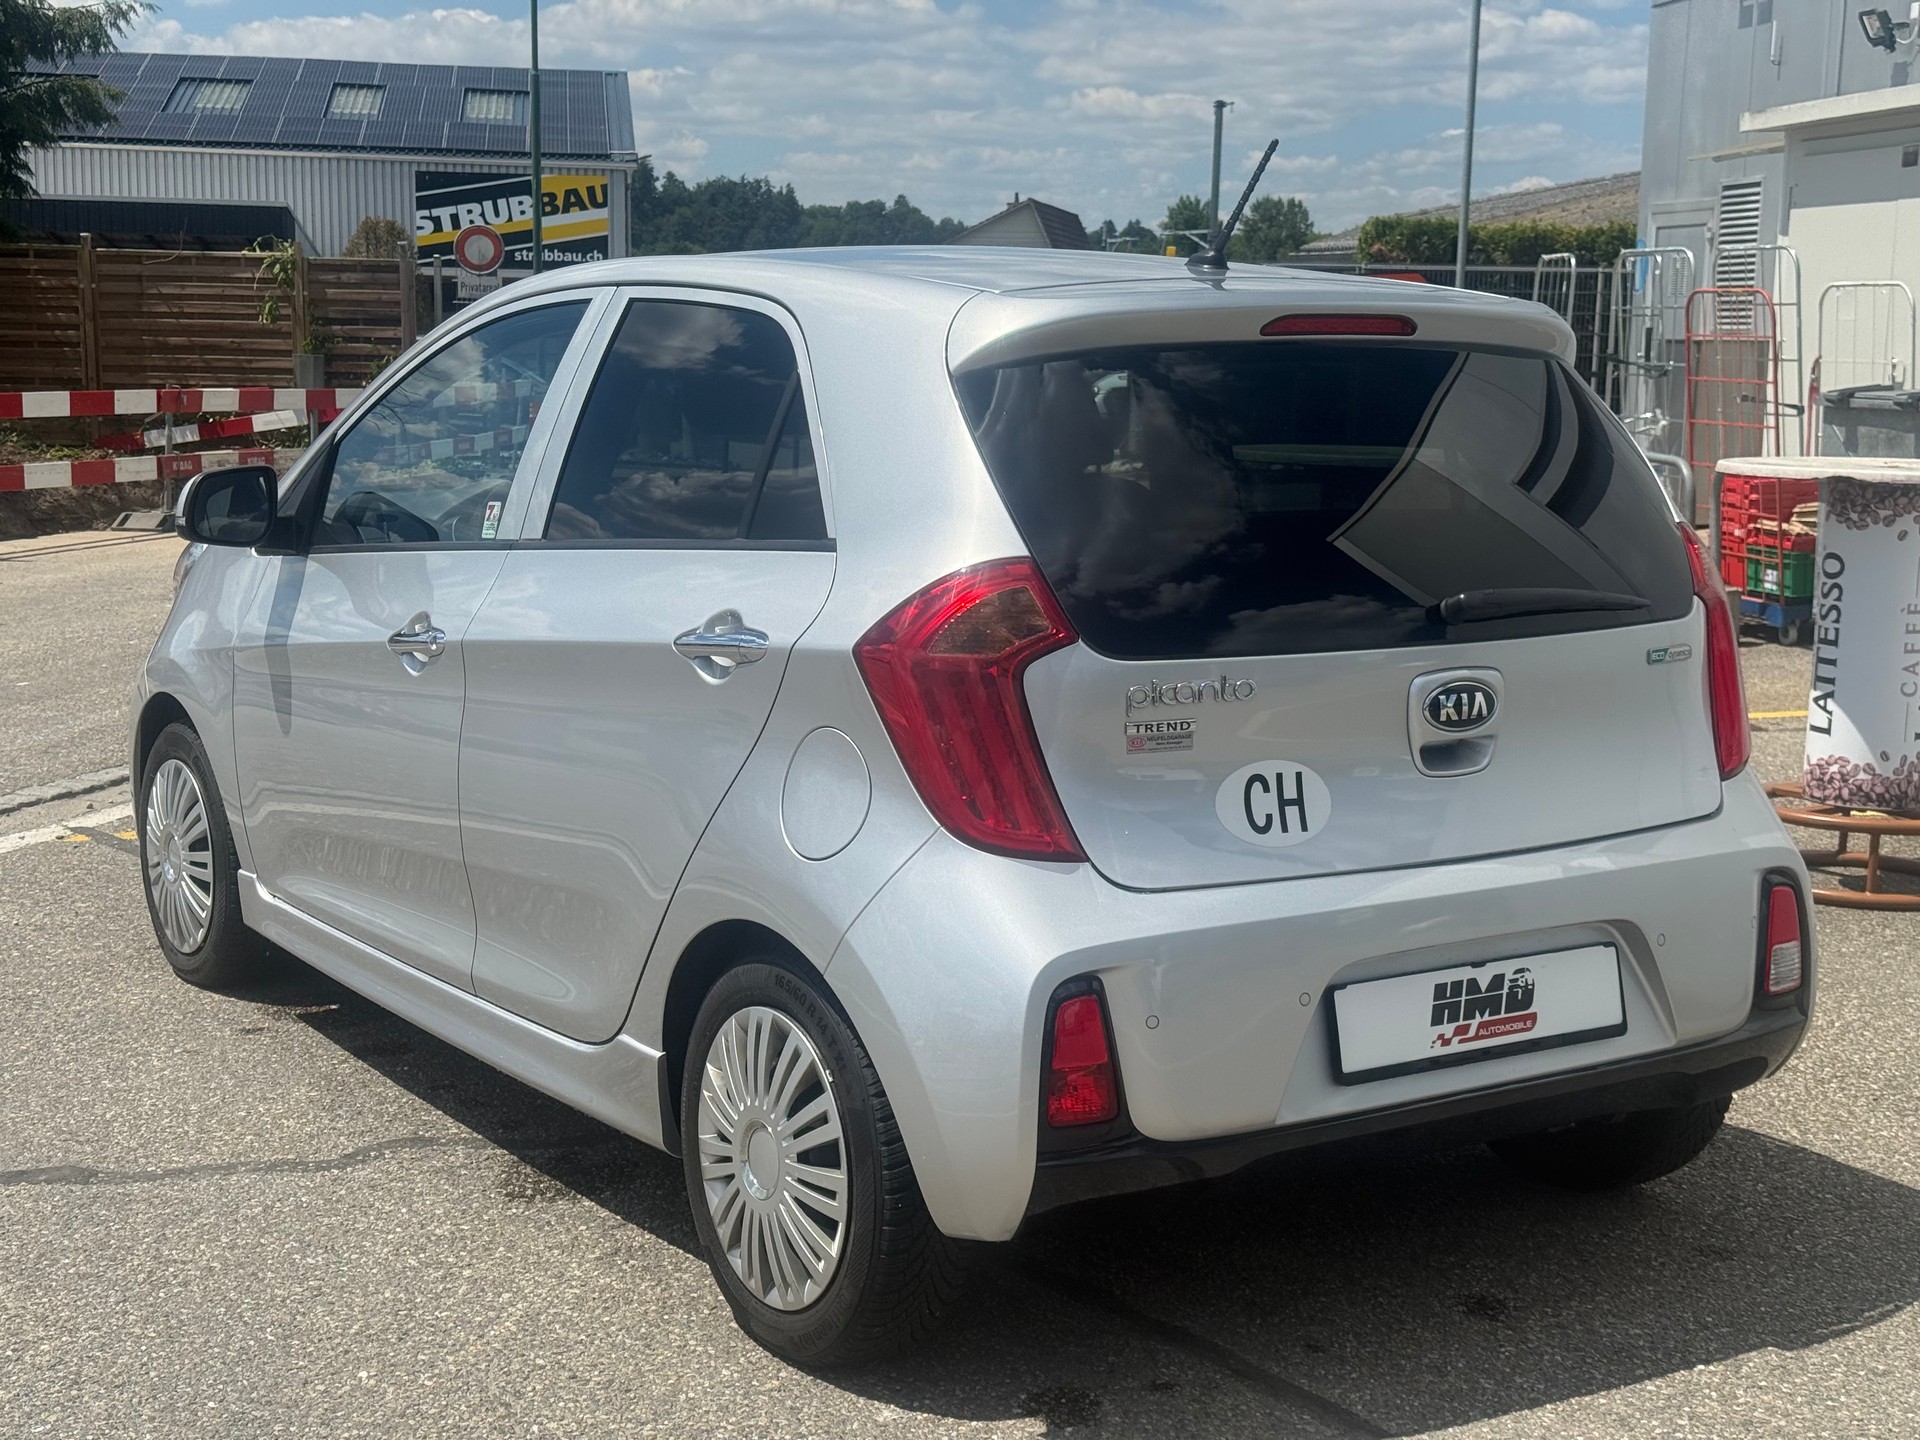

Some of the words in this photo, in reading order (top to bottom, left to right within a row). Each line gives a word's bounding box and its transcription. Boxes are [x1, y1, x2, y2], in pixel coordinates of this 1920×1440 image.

[1652, 651, 1665, 660] ECO
[1809, 552, 1845, 737] LATTESSO
[1125, 674, 1257, 717] picanto
[1437, 691, 1488, 722] KIA
[1134, 721, 1191, 733] TREND
[1243, 771, 1308, 835] CH
[774, 973, 807, 1007] 165/60
[806, 1002, 817, 1018] R
[1430, 967, 1535, 1027] HMD
[1478, 1020, 1533, 1036] AUTOMOBILE
